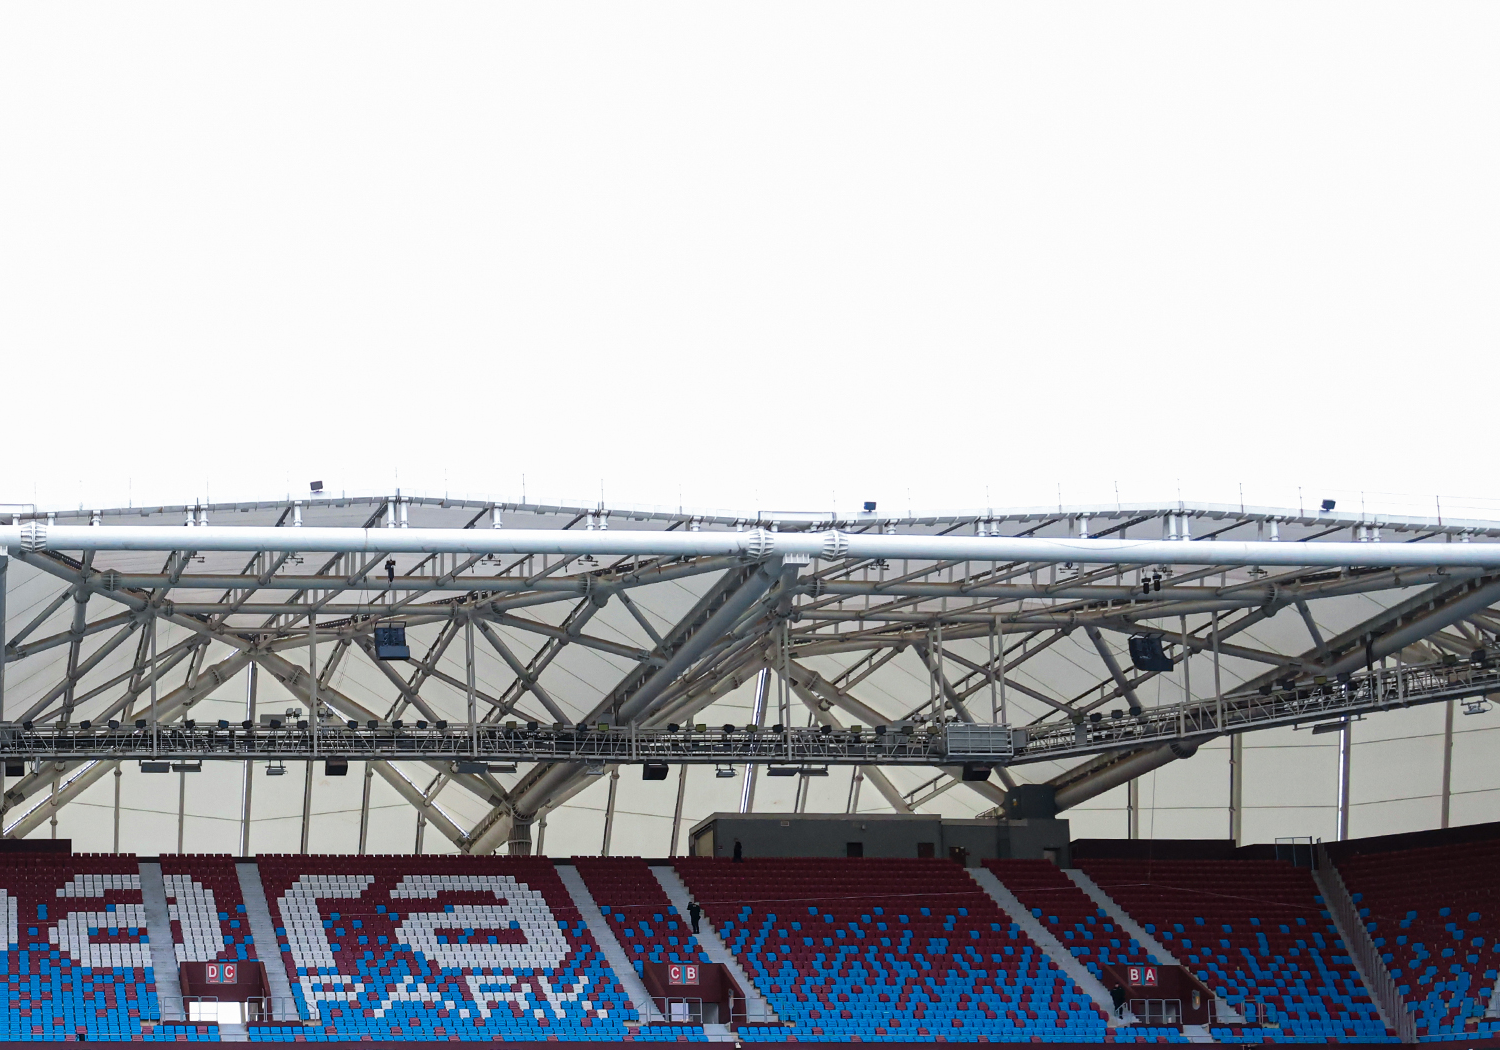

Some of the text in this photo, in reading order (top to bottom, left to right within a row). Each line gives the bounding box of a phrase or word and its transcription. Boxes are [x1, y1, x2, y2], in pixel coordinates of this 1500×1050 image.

[208, 965, 217, 978] D
[224, 965, 234, 978] C
[671, 967, 680, 979] C
[687, 967, 696, 980] B
[1130, 968, 1139, 981] B
[1146, 968, 1155, 981] A
